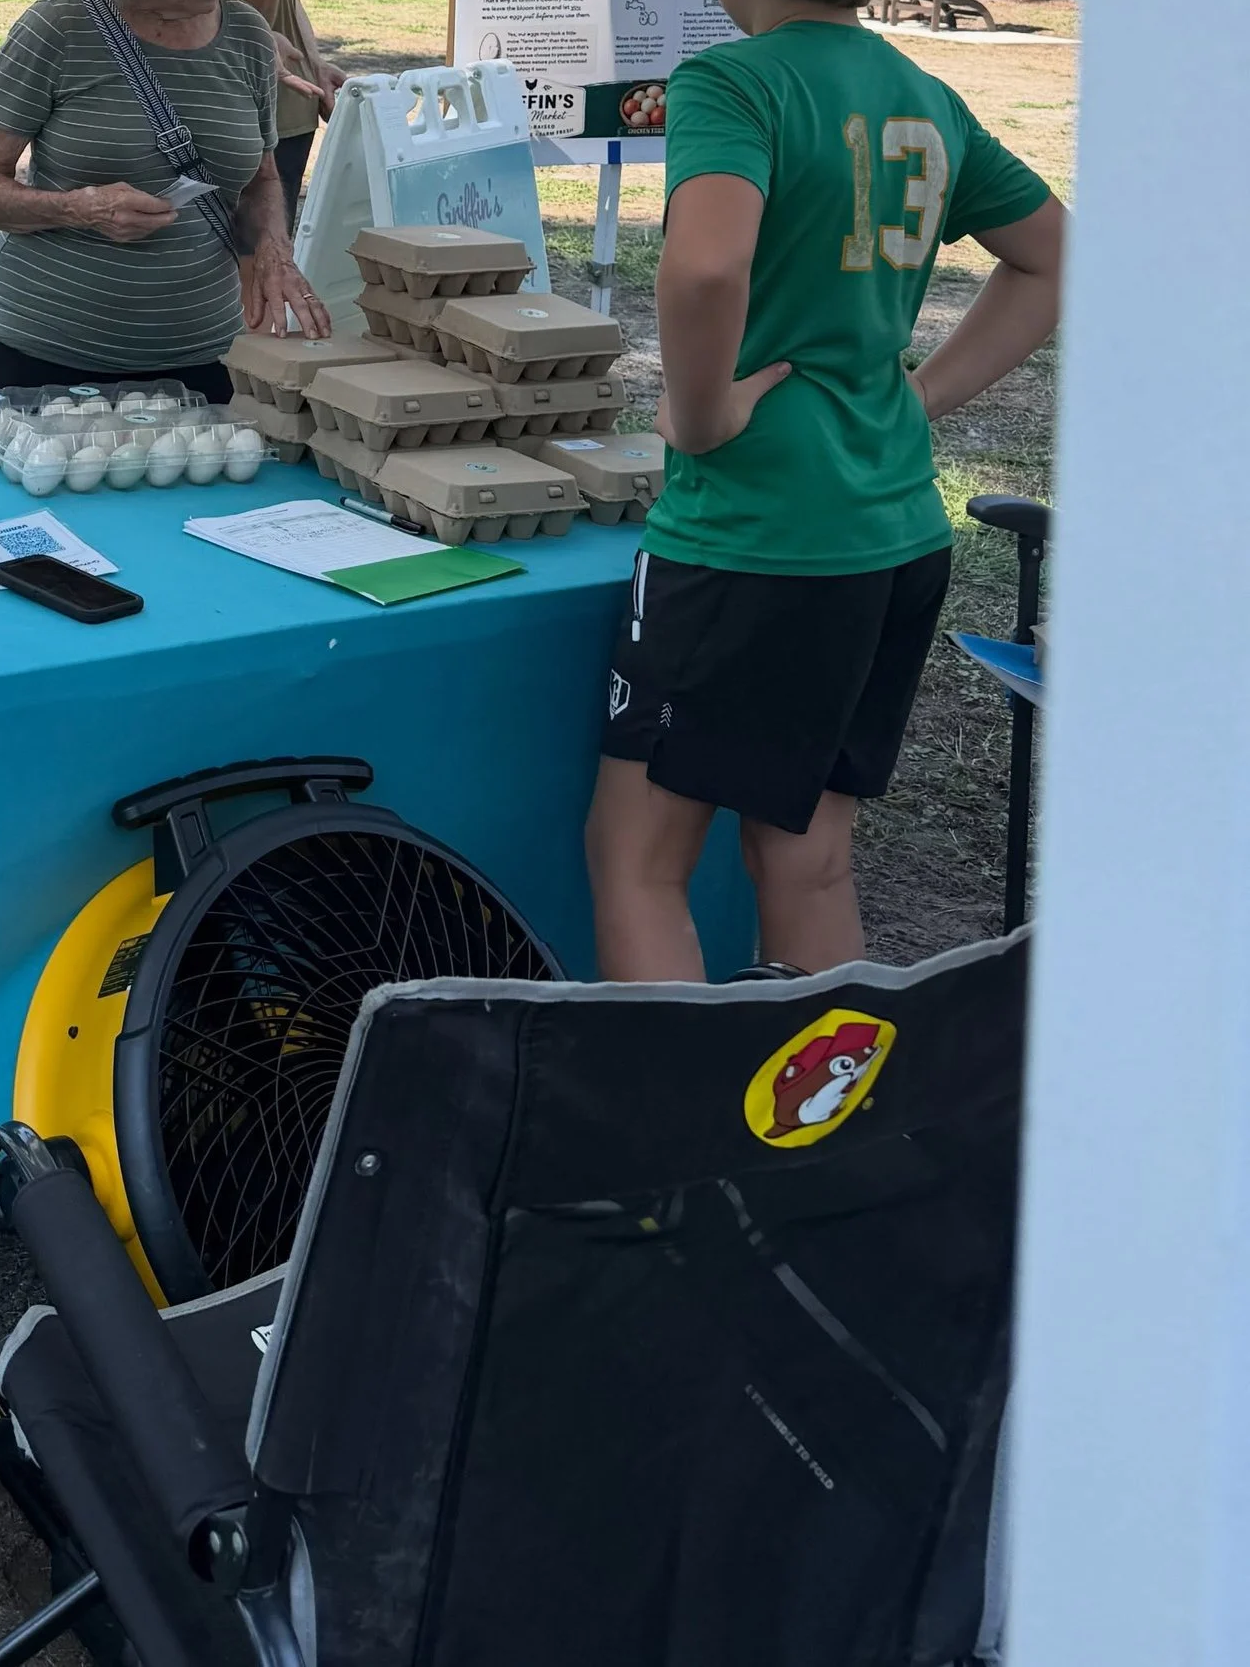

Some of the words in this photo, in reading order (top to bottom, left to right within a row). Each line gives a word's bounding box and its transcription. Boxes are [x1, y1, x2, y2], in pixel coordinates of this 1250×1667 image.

[535, 12, 555, 21] before
[531, 110, 567, 122] Market
[437, 177, 504, 229] Griffin's
[841, 113, 949, 271] 13
[796, 1443, 811, 1462] TO
[810, 1460, 835, 1490] FOLD
